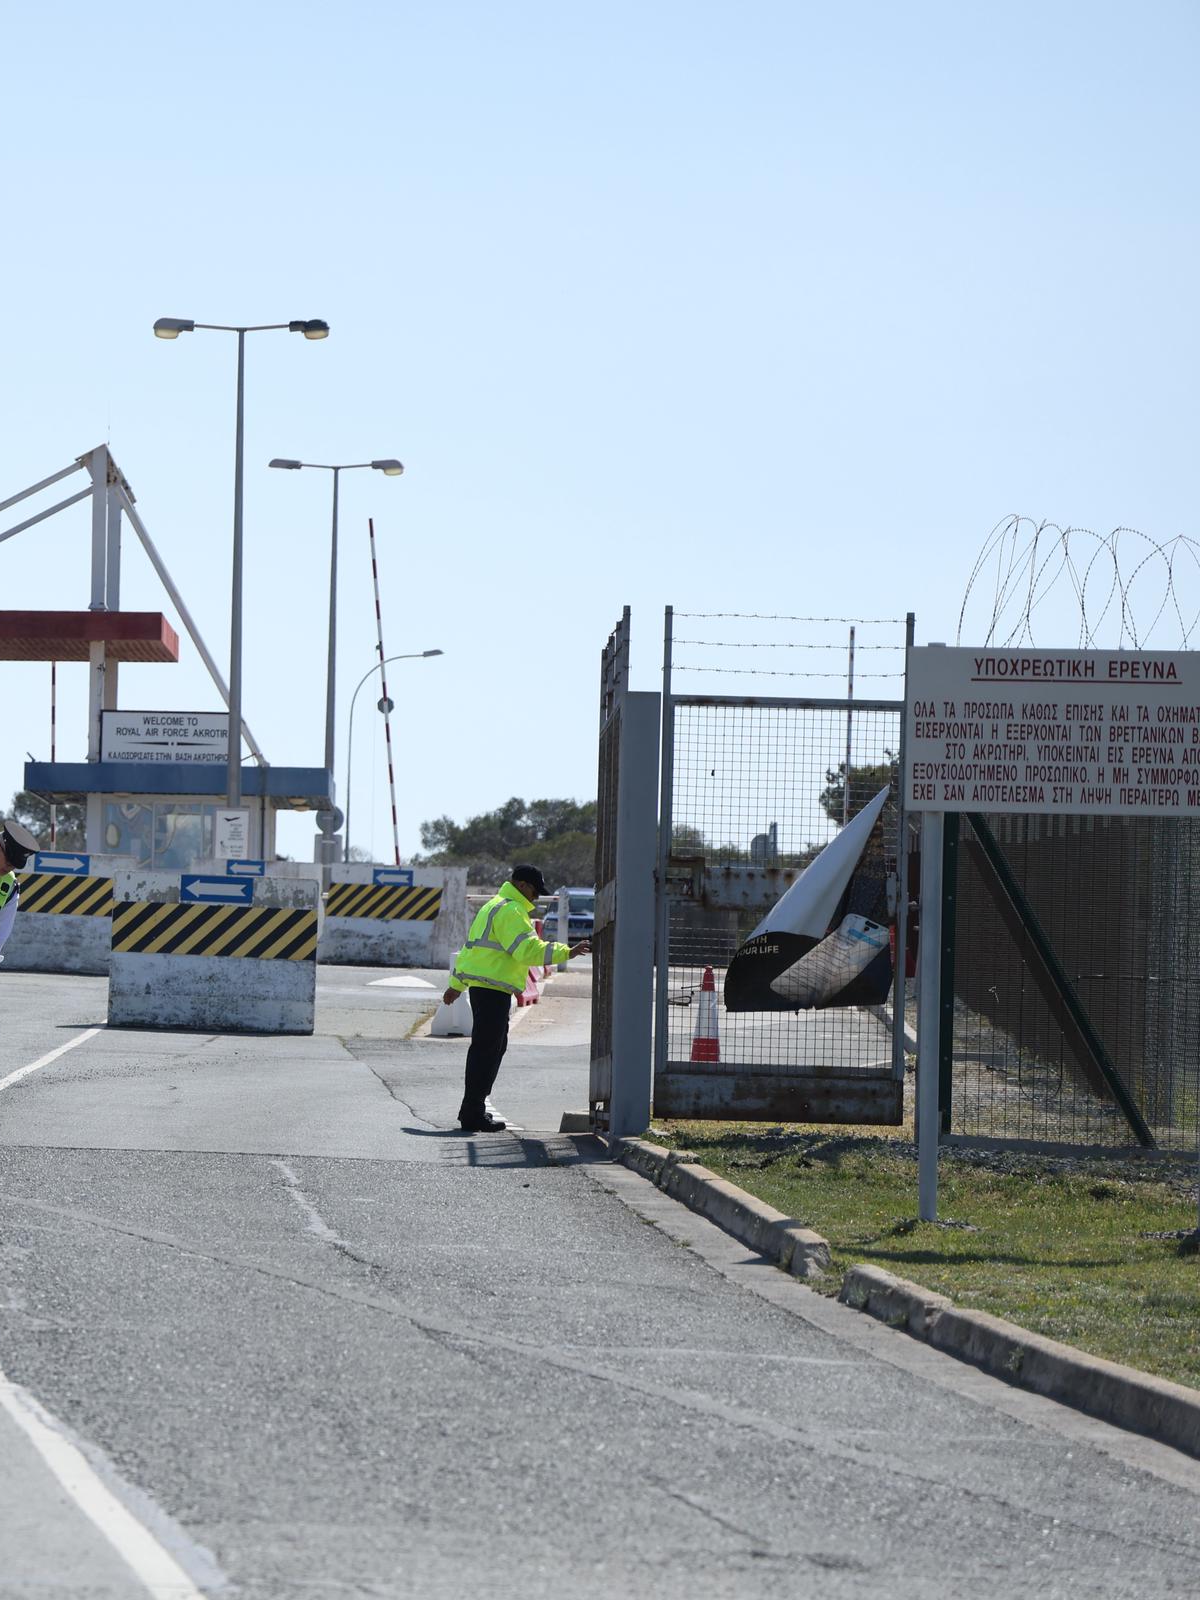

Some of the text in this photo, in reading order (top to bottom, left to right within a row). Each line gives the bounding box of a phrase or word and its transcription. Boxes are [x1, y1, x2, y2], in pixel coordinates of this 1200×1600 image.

[974, 658, 1178, 679] ΥΠΟΧΡΕΩΤΙΚΗ ΕΡΕΥΝΑ
[143, 716, 199, 727] WELCOME TO
[913, 701, 936, 718] ΟΛΑ
[943, 701, 956, 718] ΤΑ
[963, 702, 1014, 719] ΠΡΟΣΩΠΑ
[1021, 703, 1058, 720] ΚΑΘΩΣ
[1065, 703, 1104, 721] ΕΠΙΣΗΣ
[1111, 705, 1129, 721] ΚΑΙ
[1136, 705, 1150, 722] ΤΑ
[116, 727, 228, 738] ROYAL AIR FORCE AKROTIR
[915, 721, 1200, 744] ΕΙΣΕΡΧΟΝΤΑΙ Η ΕΞΕΡΧΟΝΤΑΙ ΤΩΝ ΒΡΕΤΤΑΝΙΚΩΝ Β
[945, 743, 966, 760] ΣΤΟ
[1037, 744, 1100, 762] ΥΠΟΚΕΙΝΤΑΙ
[1107, 746, 1124, 763] ΕΙΣ
[1131, 747, 1174, 764] ΕΡΕΥΝΑ
[912, 763, 1018, 781] ΕΞΟΥΣΙΟΔΟΤΗΜΕΝΟ
[1025, 765, 1090, 783] ΠΡΟΣΩΠΙΚΟ.
[1097, 767, 1105, 783] Η
[1112, 767, 1129, 784] ΜΗ
[912, 783, 936, 800] ΕΧΕΙ
[943, 784, 965, 801] ΣΑΝ
[972, 784, 1045, 802] ΑΠΟΤΕΛΕΣΜΑ
[1052, 786, 1073, 803] ΣΤΗ
[1080, 787, 1112, 804] ΛΗΨΗ
[1119, 788, 1179, 806] ΠΕΡΑΙΤΕΡΩ
[759, 945, 780, 954] LIFE
